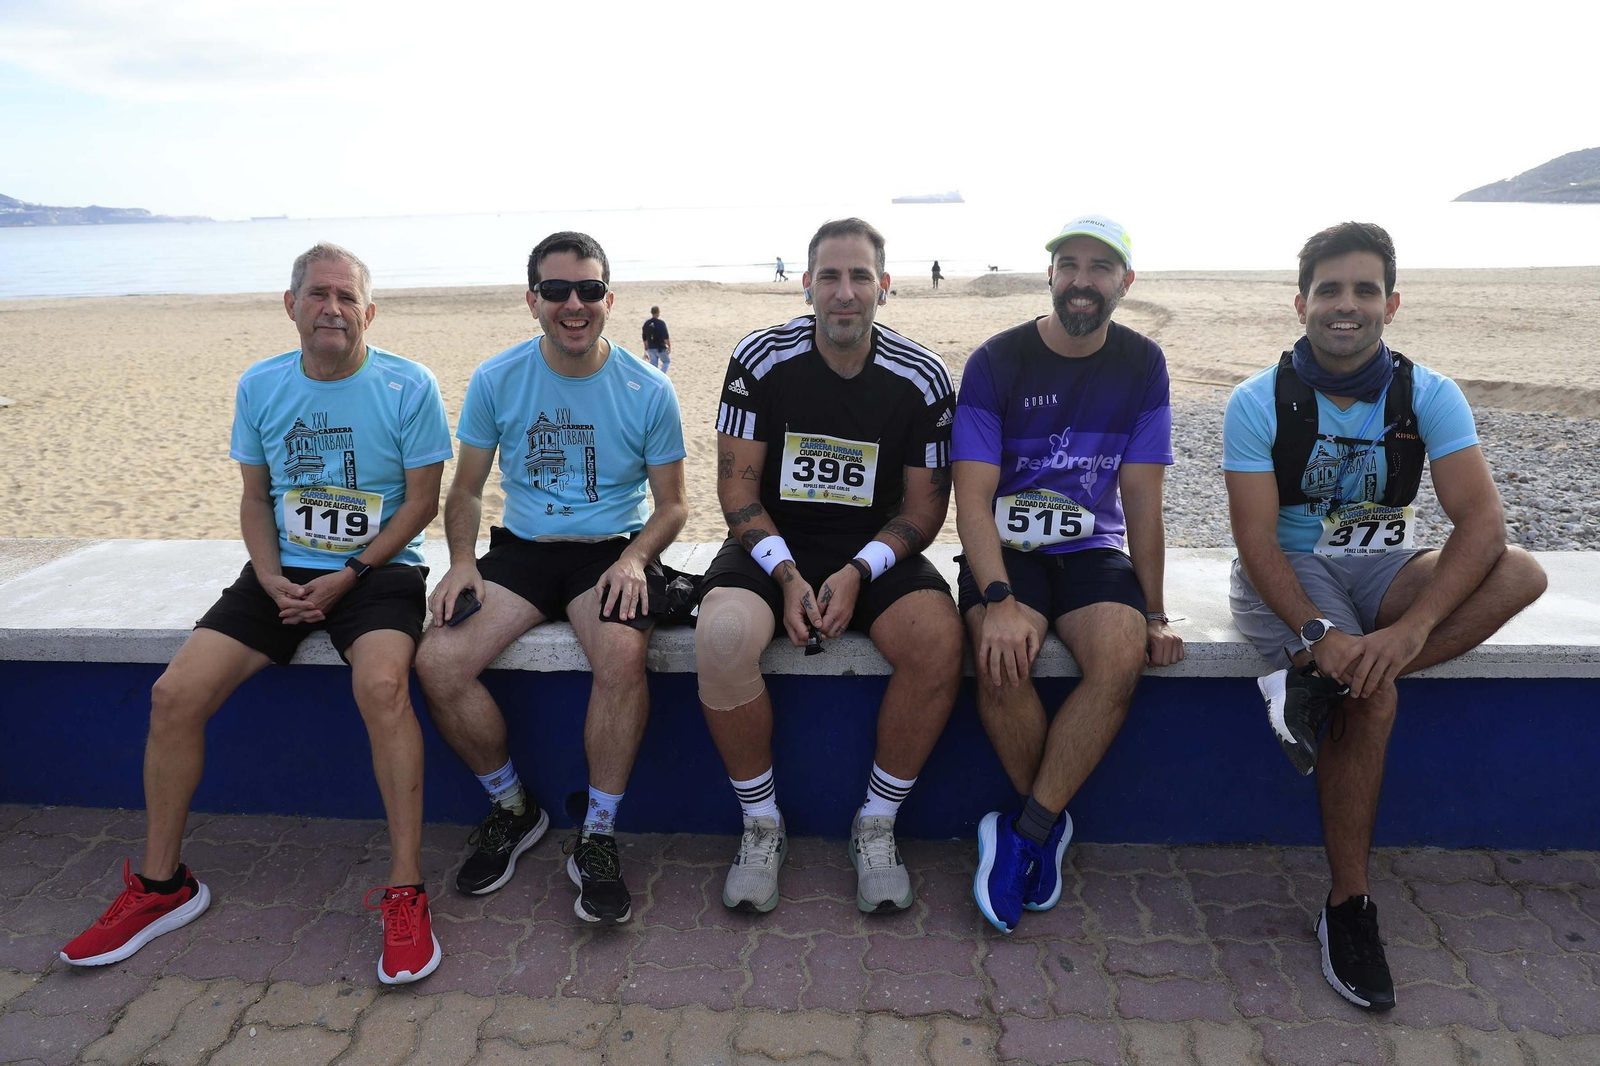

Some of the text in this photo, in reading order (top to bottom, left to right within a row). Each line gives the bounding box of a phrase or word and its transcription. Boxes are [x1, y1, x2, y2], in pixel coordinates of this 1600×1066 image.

[728, 384, 749, 396] adidas
[1024, 394, 1058, 408] GOBIK
[311, 411, 328, 429] XXV
[555, 408, 571, 424] XXV
[318, 427, 353, 435] CARRERA
[561, 430, 595, 446] URBANA
[318, 434, 354, 451] URBANA
[800, 441, 832, 451] CARRERA
[833, 445, 863, 456] URBANA
[800, 449, 822, 457] CIUDAD
[831, 452, 863, 463] ALGECIRAS
[792, 456, 866, 487] 396
[300, 491, 366, 506] CARRERA URBANA
[300, 497, 366, 512] CIUDAD DE ALGECIRAS
[1015, 493, 1048, 502] CARRERA
[1015, 500, 1038, 508] CIUDAD
[1046, 503, 1079, 512] ALGECIRAS
[295, 505, 369, 537] 119
[1007, 506, 1083, 537] 515
[1338, 509, 1371, 520] CARRERA
[1340, 518, 1361, 527] CIUDAD
[1371, 511, 1403, 521] ALGECIRAS
[1328, 520, 1406, 547] 373
